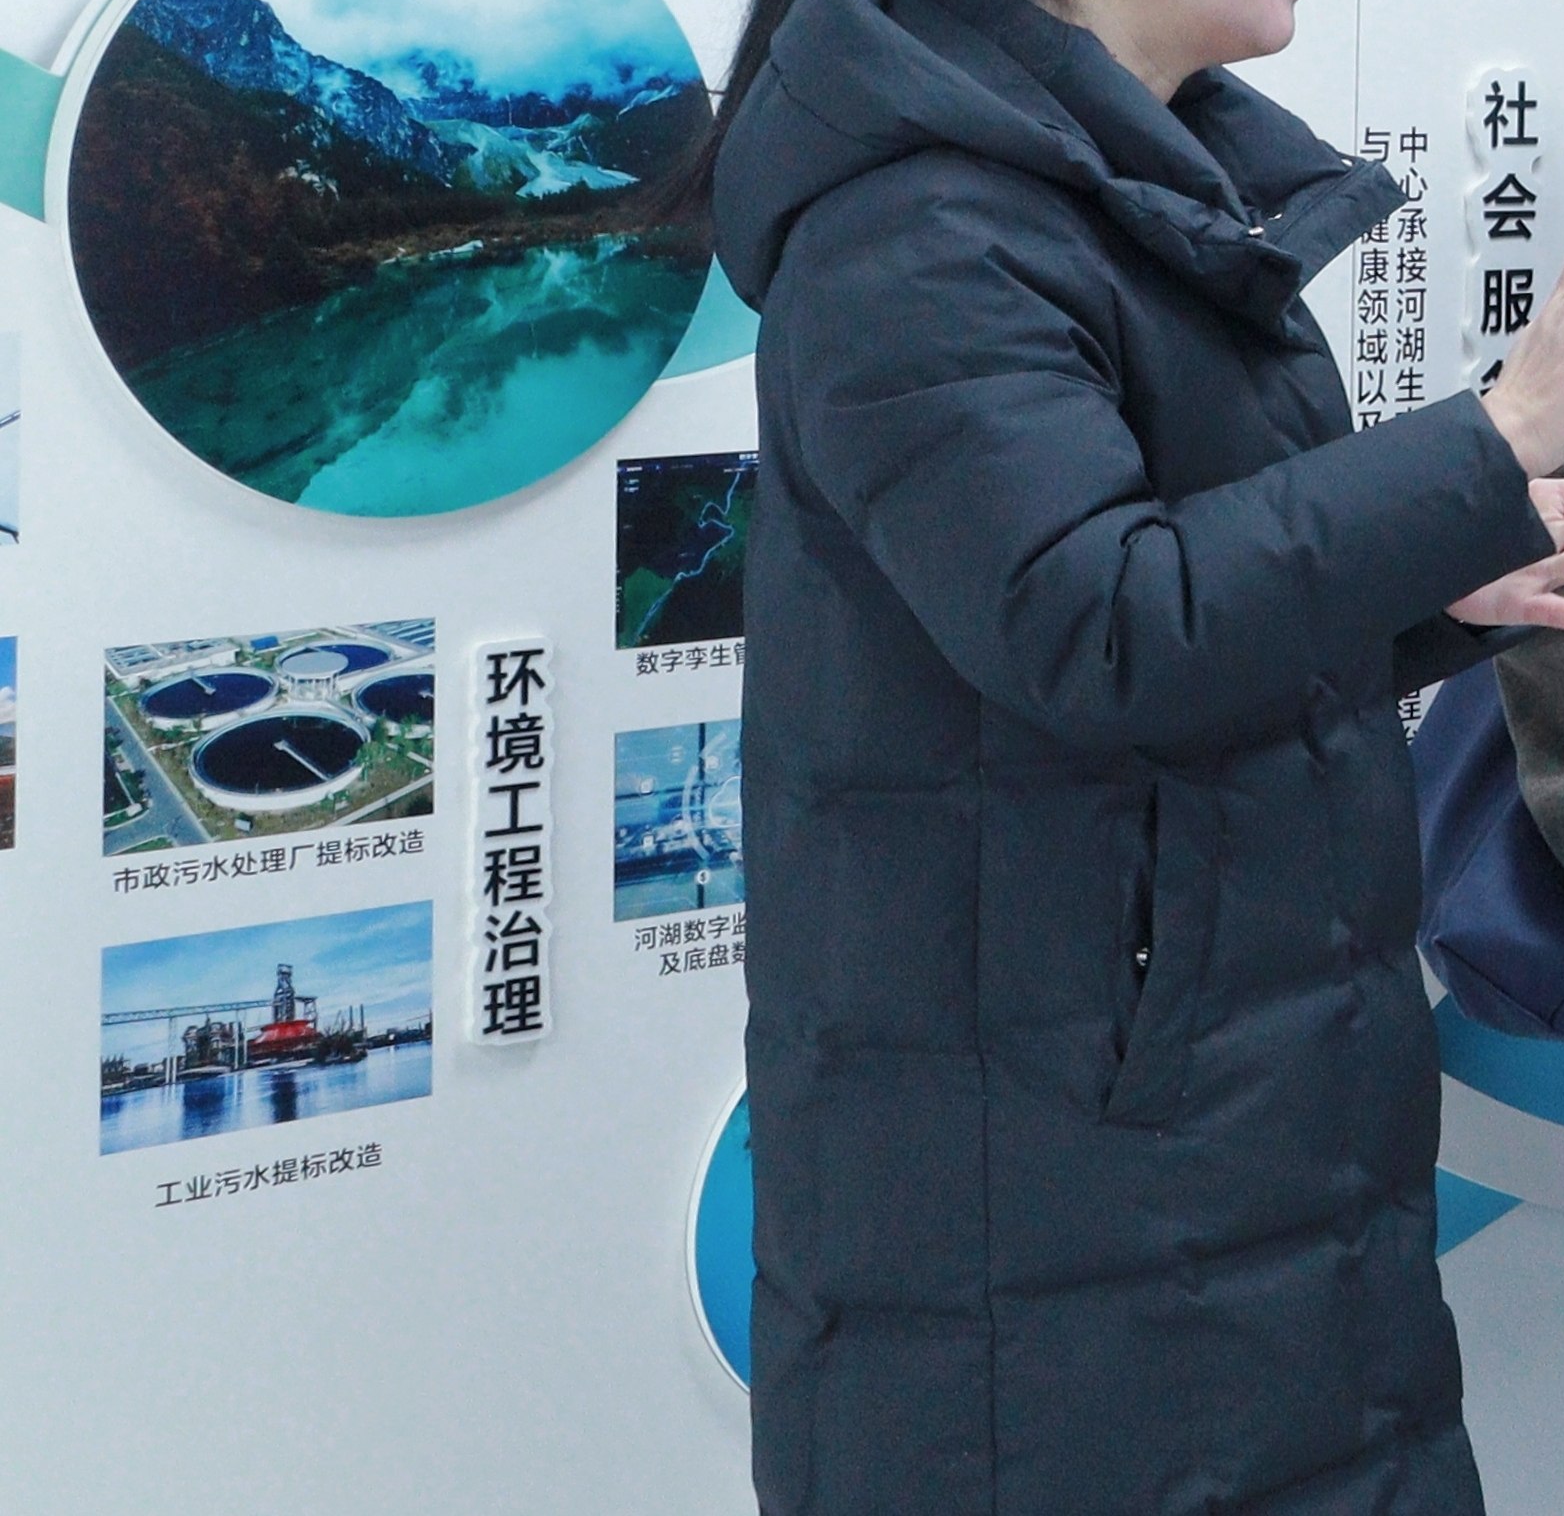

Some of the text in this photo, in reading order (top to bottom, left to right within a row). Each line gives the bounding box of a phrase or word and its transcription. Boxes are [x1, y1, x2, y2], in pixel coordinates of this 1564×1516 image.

[1395, 126, 1428, 414] 中心承接河湖生
[1479, 81, 1540, 397] 社会服
[113, 830, 425, 895] 市政污水处理厂提标改造
[482, 648, 546, 1036] 环境工程治理
[154, 1142, 383, 1207] 工业污水提标改造
